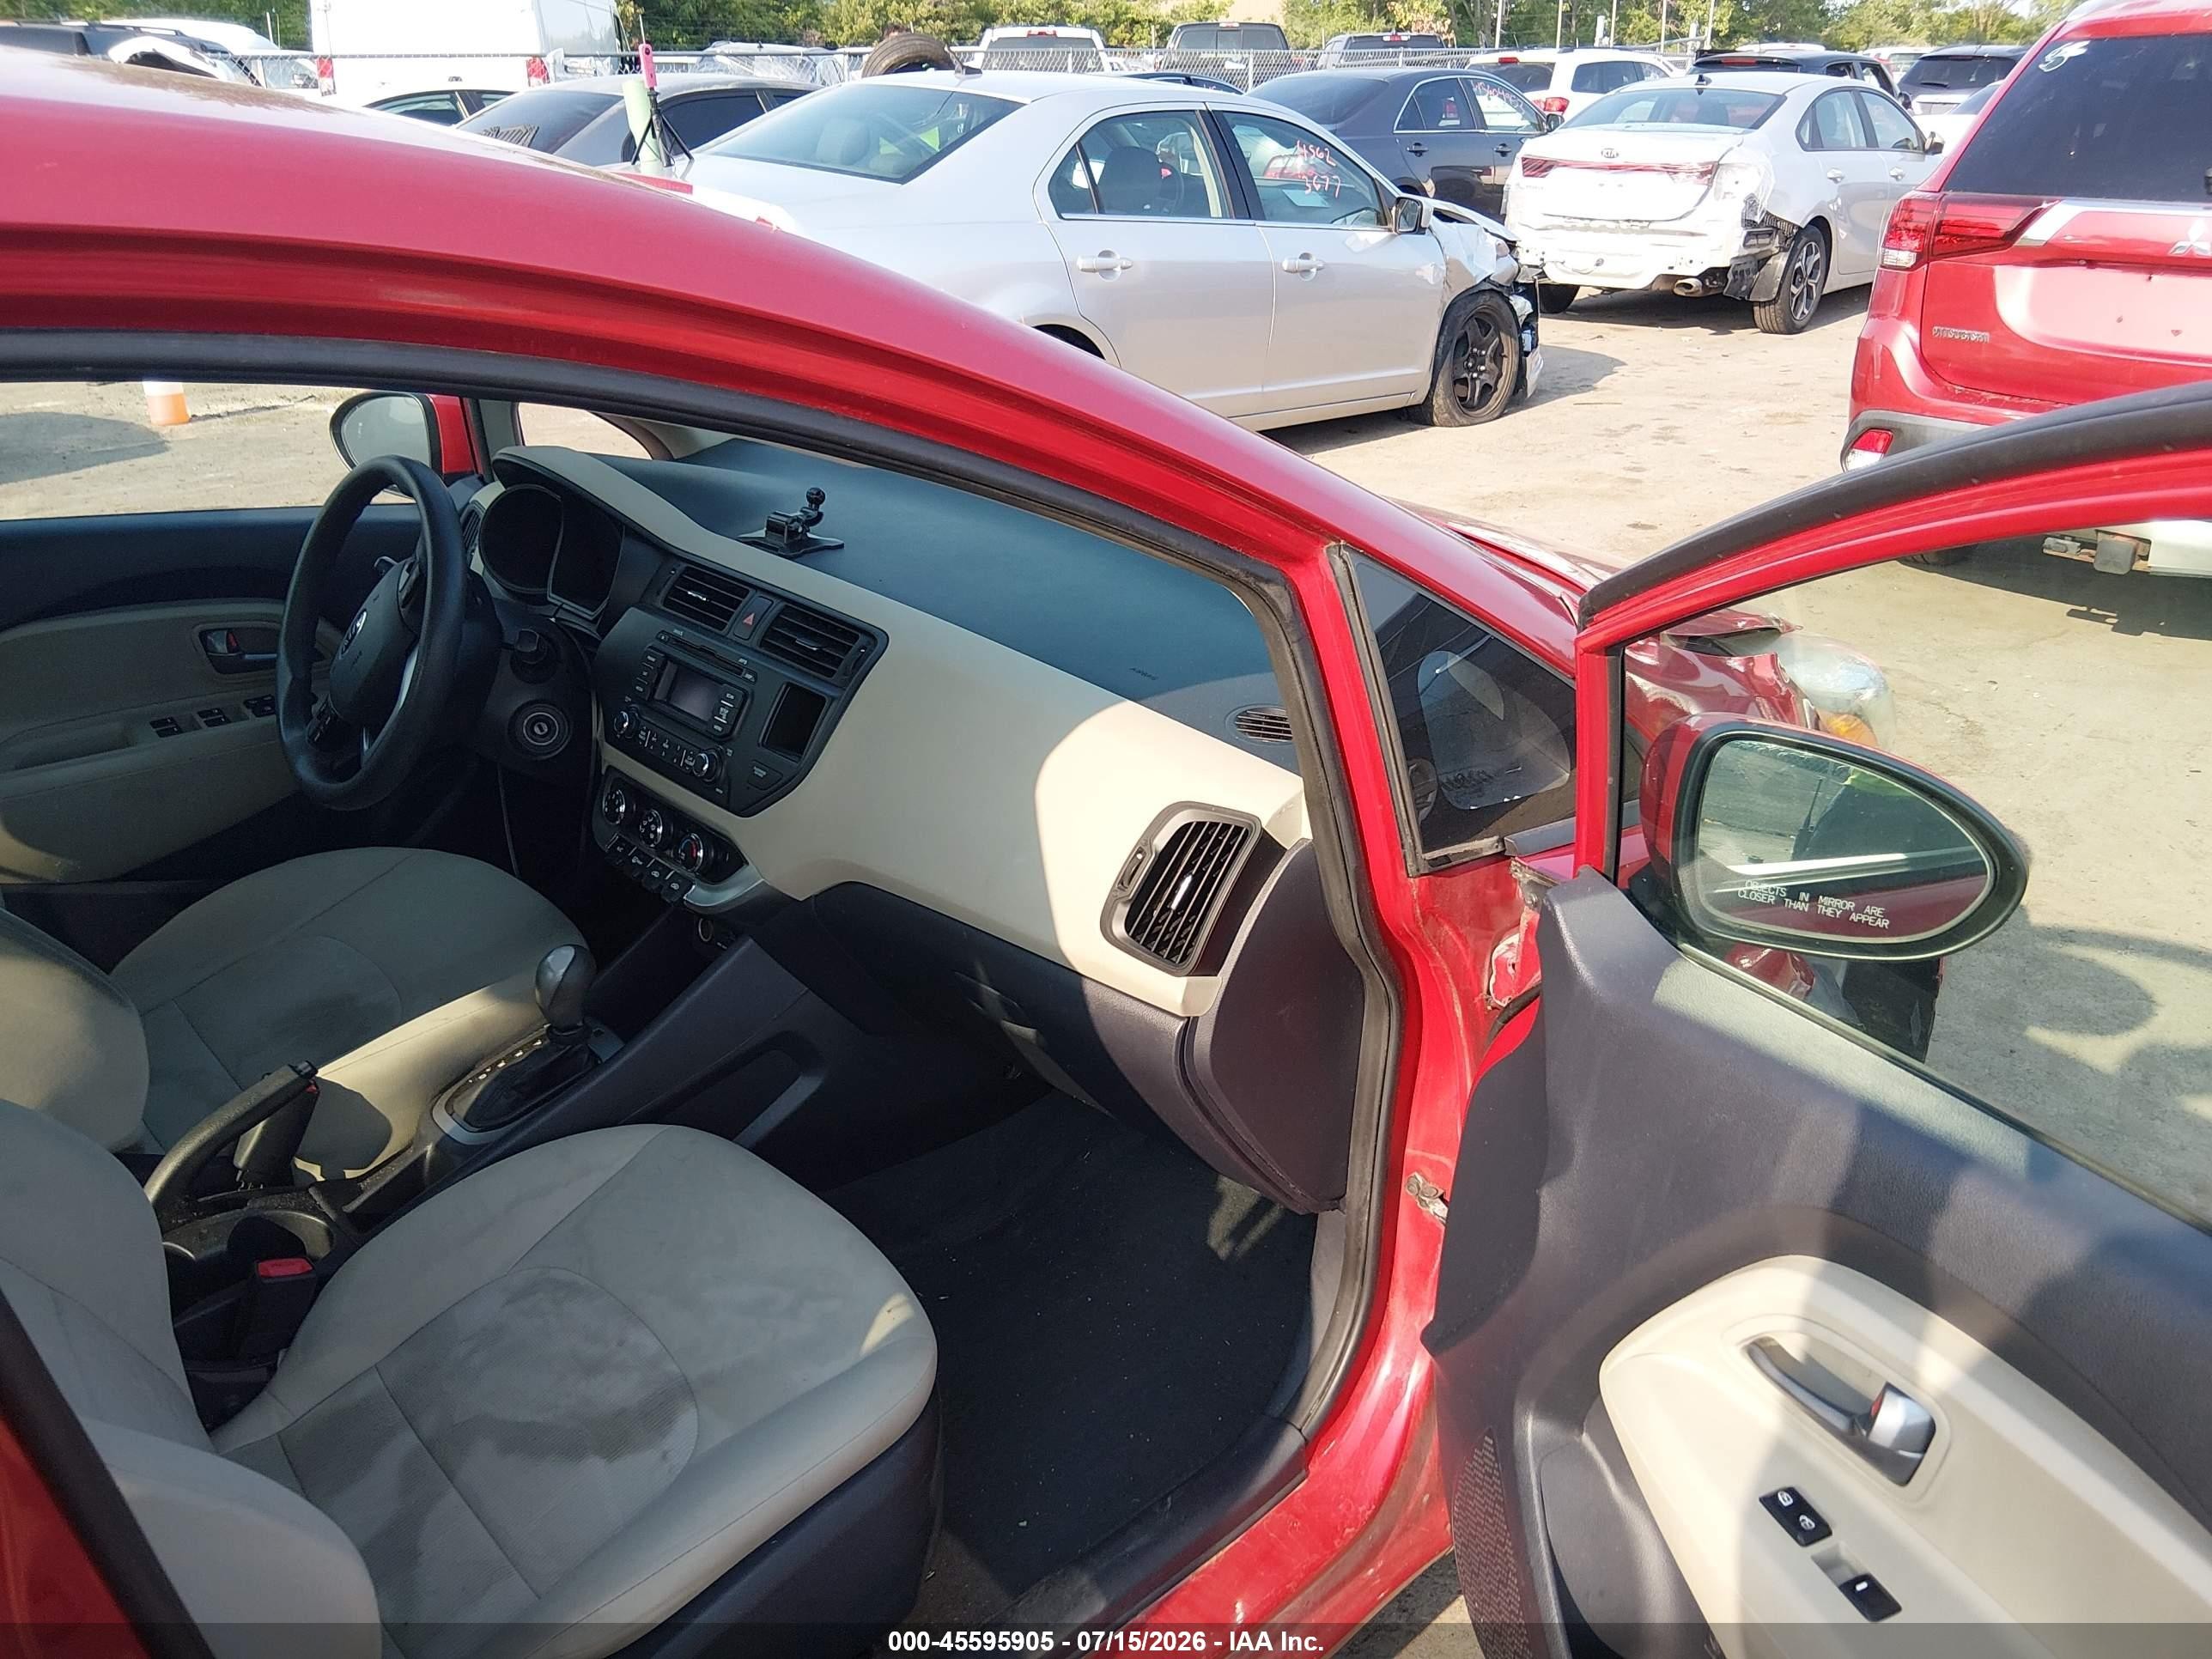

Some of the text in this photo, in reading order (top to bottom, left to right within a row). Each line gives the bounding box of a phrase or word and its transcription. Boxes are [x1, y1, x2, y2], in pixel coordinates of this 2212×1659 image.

[1297, 140, 1336, 167] 4562
[1302, 175, 1341, 198] 3677
[1738, 890, 1889, 929] CLOSER THAN THEY APPEAR
[1745, 880, 1885, 918] OBJECTS IN MIRROR ARE
